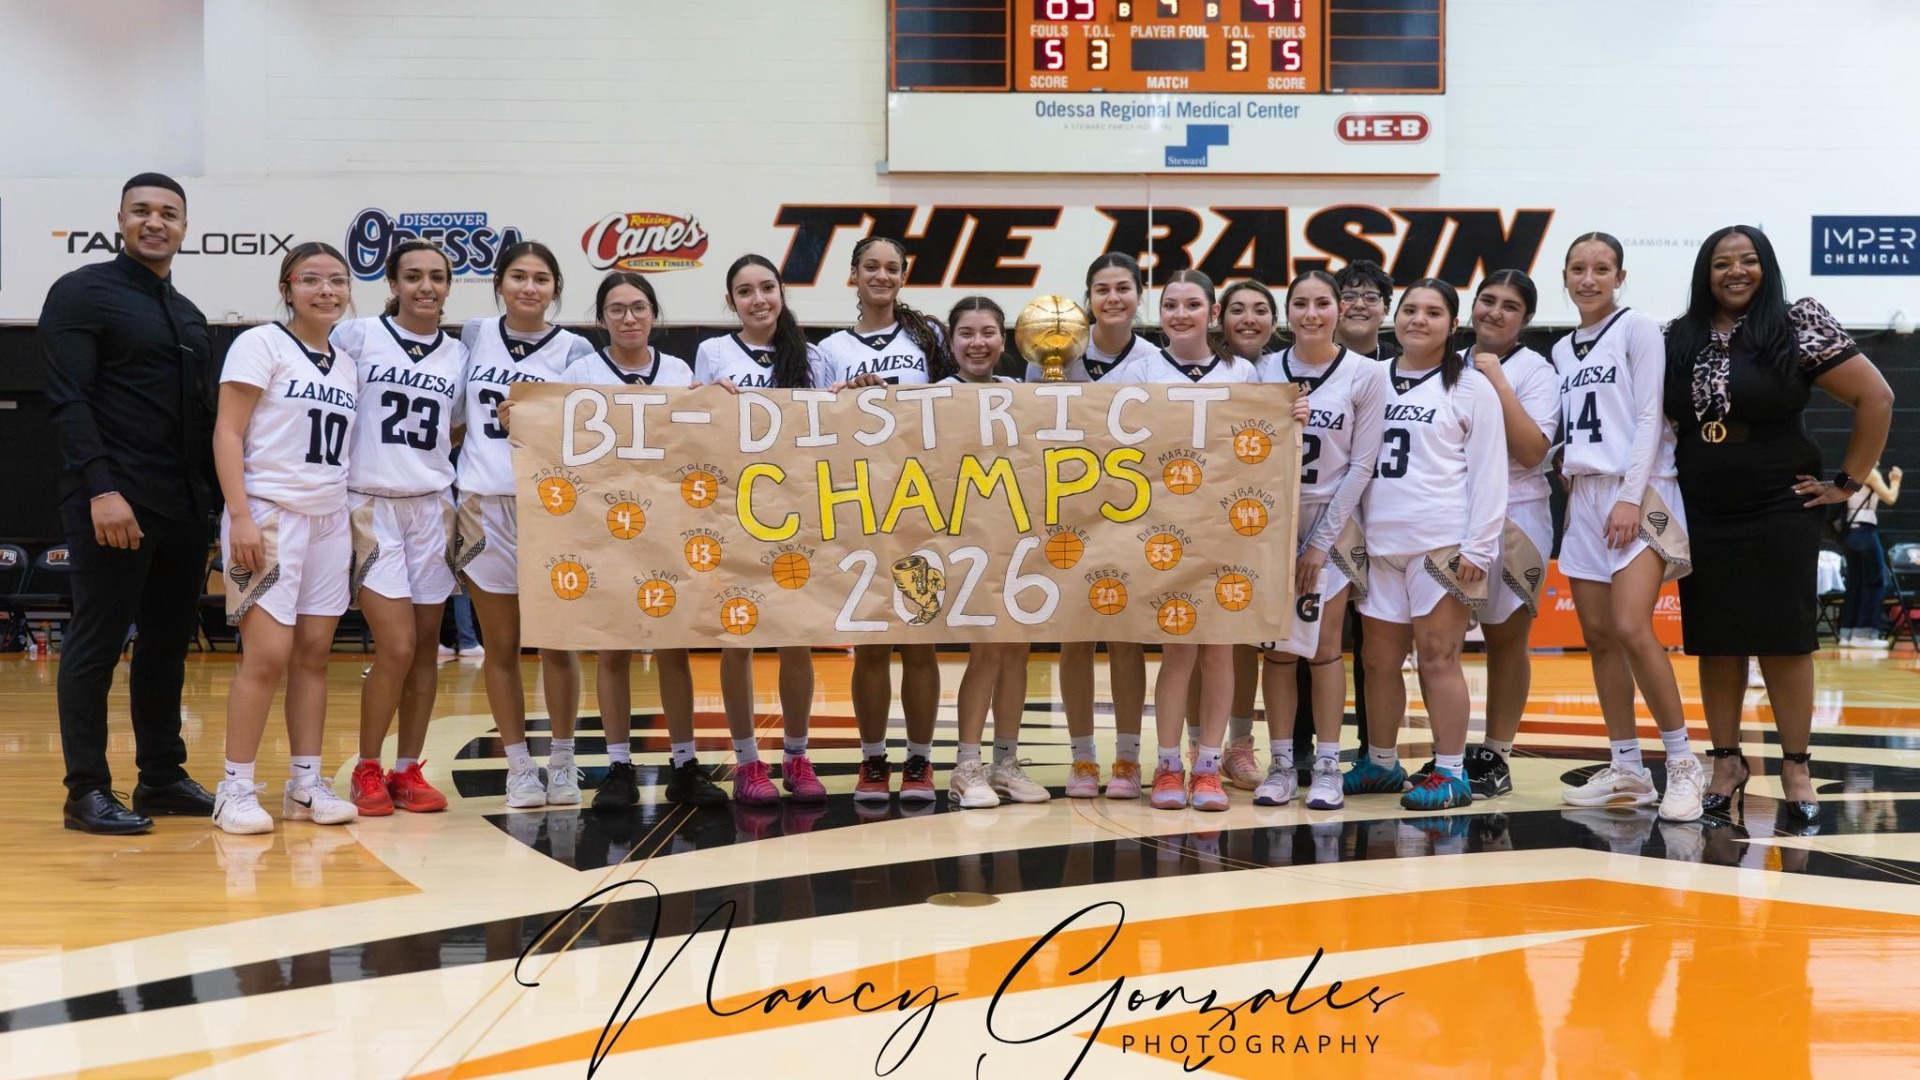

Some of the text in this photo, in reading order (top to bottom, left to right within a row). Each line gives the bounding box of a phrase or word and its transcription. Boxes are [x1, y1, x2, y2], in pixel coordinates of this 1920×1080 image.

[1030, 24, 1069, 38] FOULS
[1082, 25, 1115, 38] T.O.L.
[1130, 25, 1209, 38] PLAYER FOUL
[1222, 26, 1255, 38] T.O.L.
[1267, 26, 1306, 38] FOULS
[1045, 39, 1063, 69] 5
[1091, 39, 1108, 69] 3
[1231, 40, 1247, 70] 3
[1283, 40, 1300, 70] 5
[1030, 75, 1069, 88] SCORE
[1146, 76, 1189, 88] MATCH
[1267, 77, 1306, 89] SCORE
[1035, 100, 1300, 122] Odessa Regional Medical Center
[403, 214, 485, 226] DISCOVER
[630, 214, 672, 227] Raising
[587, 212, 708, 270] Cane's
[773, 204, 1555, 290] THE BASIN
[1824, 227, 1917, 249] IMPER
[1824, 253, 1910, 264] CHEMICAL
[846, 354, 926, 382] LAMESA
[366, 365, 456, 399] LAMESA
[381, 390, 440, 451] 23
[1308, 409, 1346, 430] ESA
[1384, 404, 1437, 424] MESA
[305, 408, 349, 466] 10
[1230, 419, 1278, 437] AUBREY
[1236, 435, 1261, 457] 35
[1372, 428, 1411, 478] 3
[1157, 448, 1207, 467] MARIELA
[675, 462, 729, 485] TALEESA
[1170, 465, 1194, 485] 24
[549, 487, 563, 507] 3
[604, 490, 652, 511] BELLA
[691, 480, 707, 501] 5
[736, 447, 1152, 542] CHAMPS
[1219, 486, 1276, 510] MYRANDA
[617, 511, 630, 531] 4
[1237, 506, 1260, 528] 44
[680, 528, 729, 544] JORDAN
[1045, 525, 1091, 544] KAYLEE
[692, 544, 712, 564] 13
[760, 544, 816, 565] PALOMA
[1150, 543, 1173, 562] 33
[557, 570, 579, 590] 10
[633, 569, 679, 586] ELENA
[834, 536, 1060, 632] 2026
[1084, 570, 1130, 585] REESE
[645, 588, 667, 608] 12
[713, 586, 767, 604] JESSIE
[1097, 587, 1119, 605] 20
[1149, 591, 1203, 609] NICOLE
[1222, 583, 1245, 603] 45
[729, 605, 750, 625] 15
[1165, 606, 1188, 627] 23
